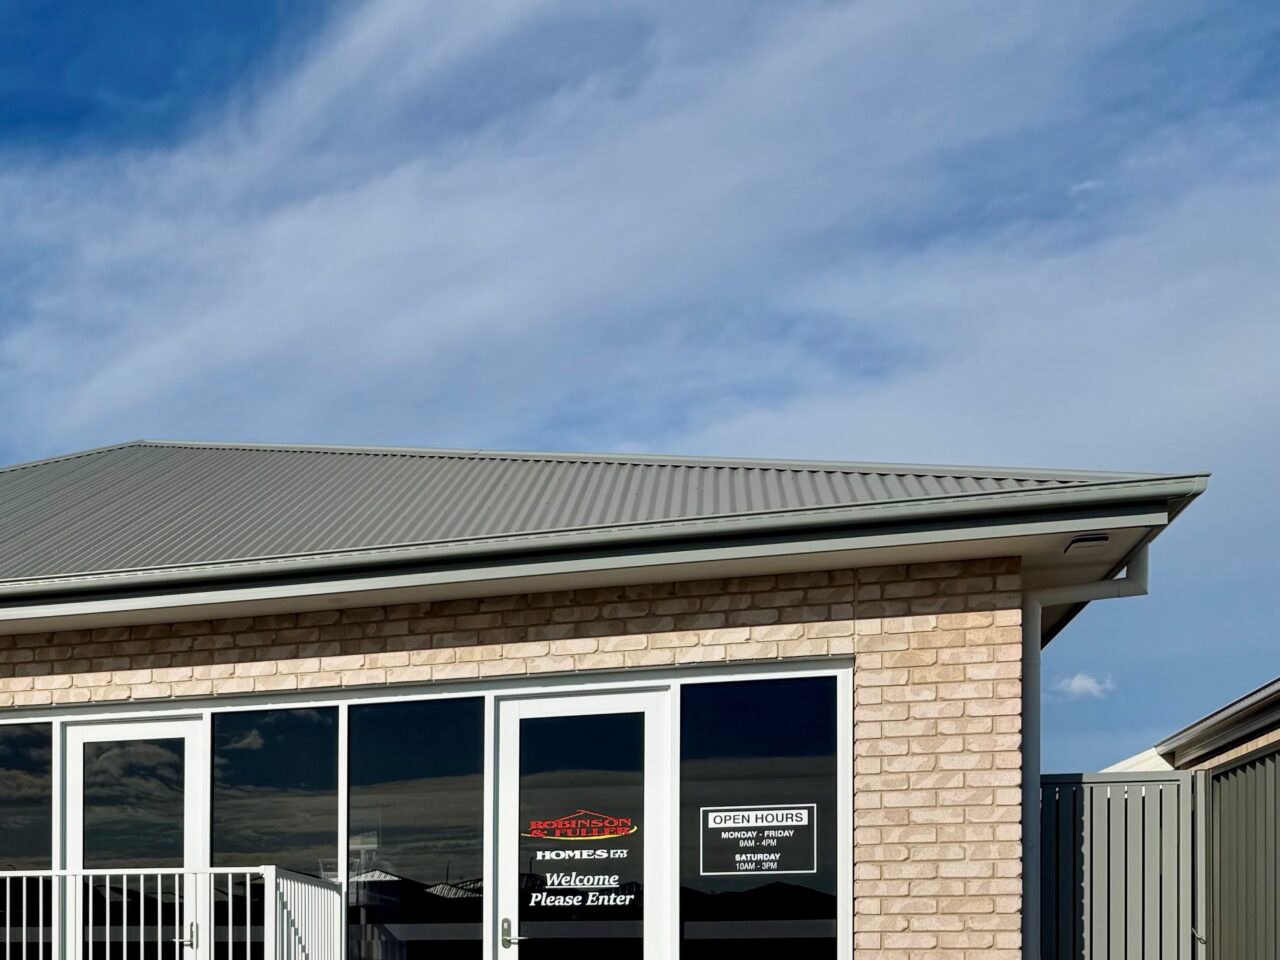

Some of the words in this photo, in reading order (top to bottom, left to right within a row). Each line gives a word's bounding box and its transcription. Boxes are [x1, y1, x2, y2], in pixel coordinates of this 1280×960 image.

[529, 818, 631, 829] ROBINSON
[713, 814, 750, 824] OPEN
[755, 812, 804, 823] HOURS
[530, 829, 547, 838] &
[555, 827, 631, 837] FULLER
[721, 831, 758, 839] MONDAY
[764, 829, 795, 838] FRIDAY
[761, 838, 777, 847] 4PM
[536, 849, 609, 860] HOMES
[735, 853, 781, 861] SATURDAY
[735, 862, 756, 871] 10AM
[761, 861, 778, 870] 3PM
[545, 872, 620, 888] Welcome
[529, 892, 583, 906] Please
[585, 892, 635, 906] Enter
